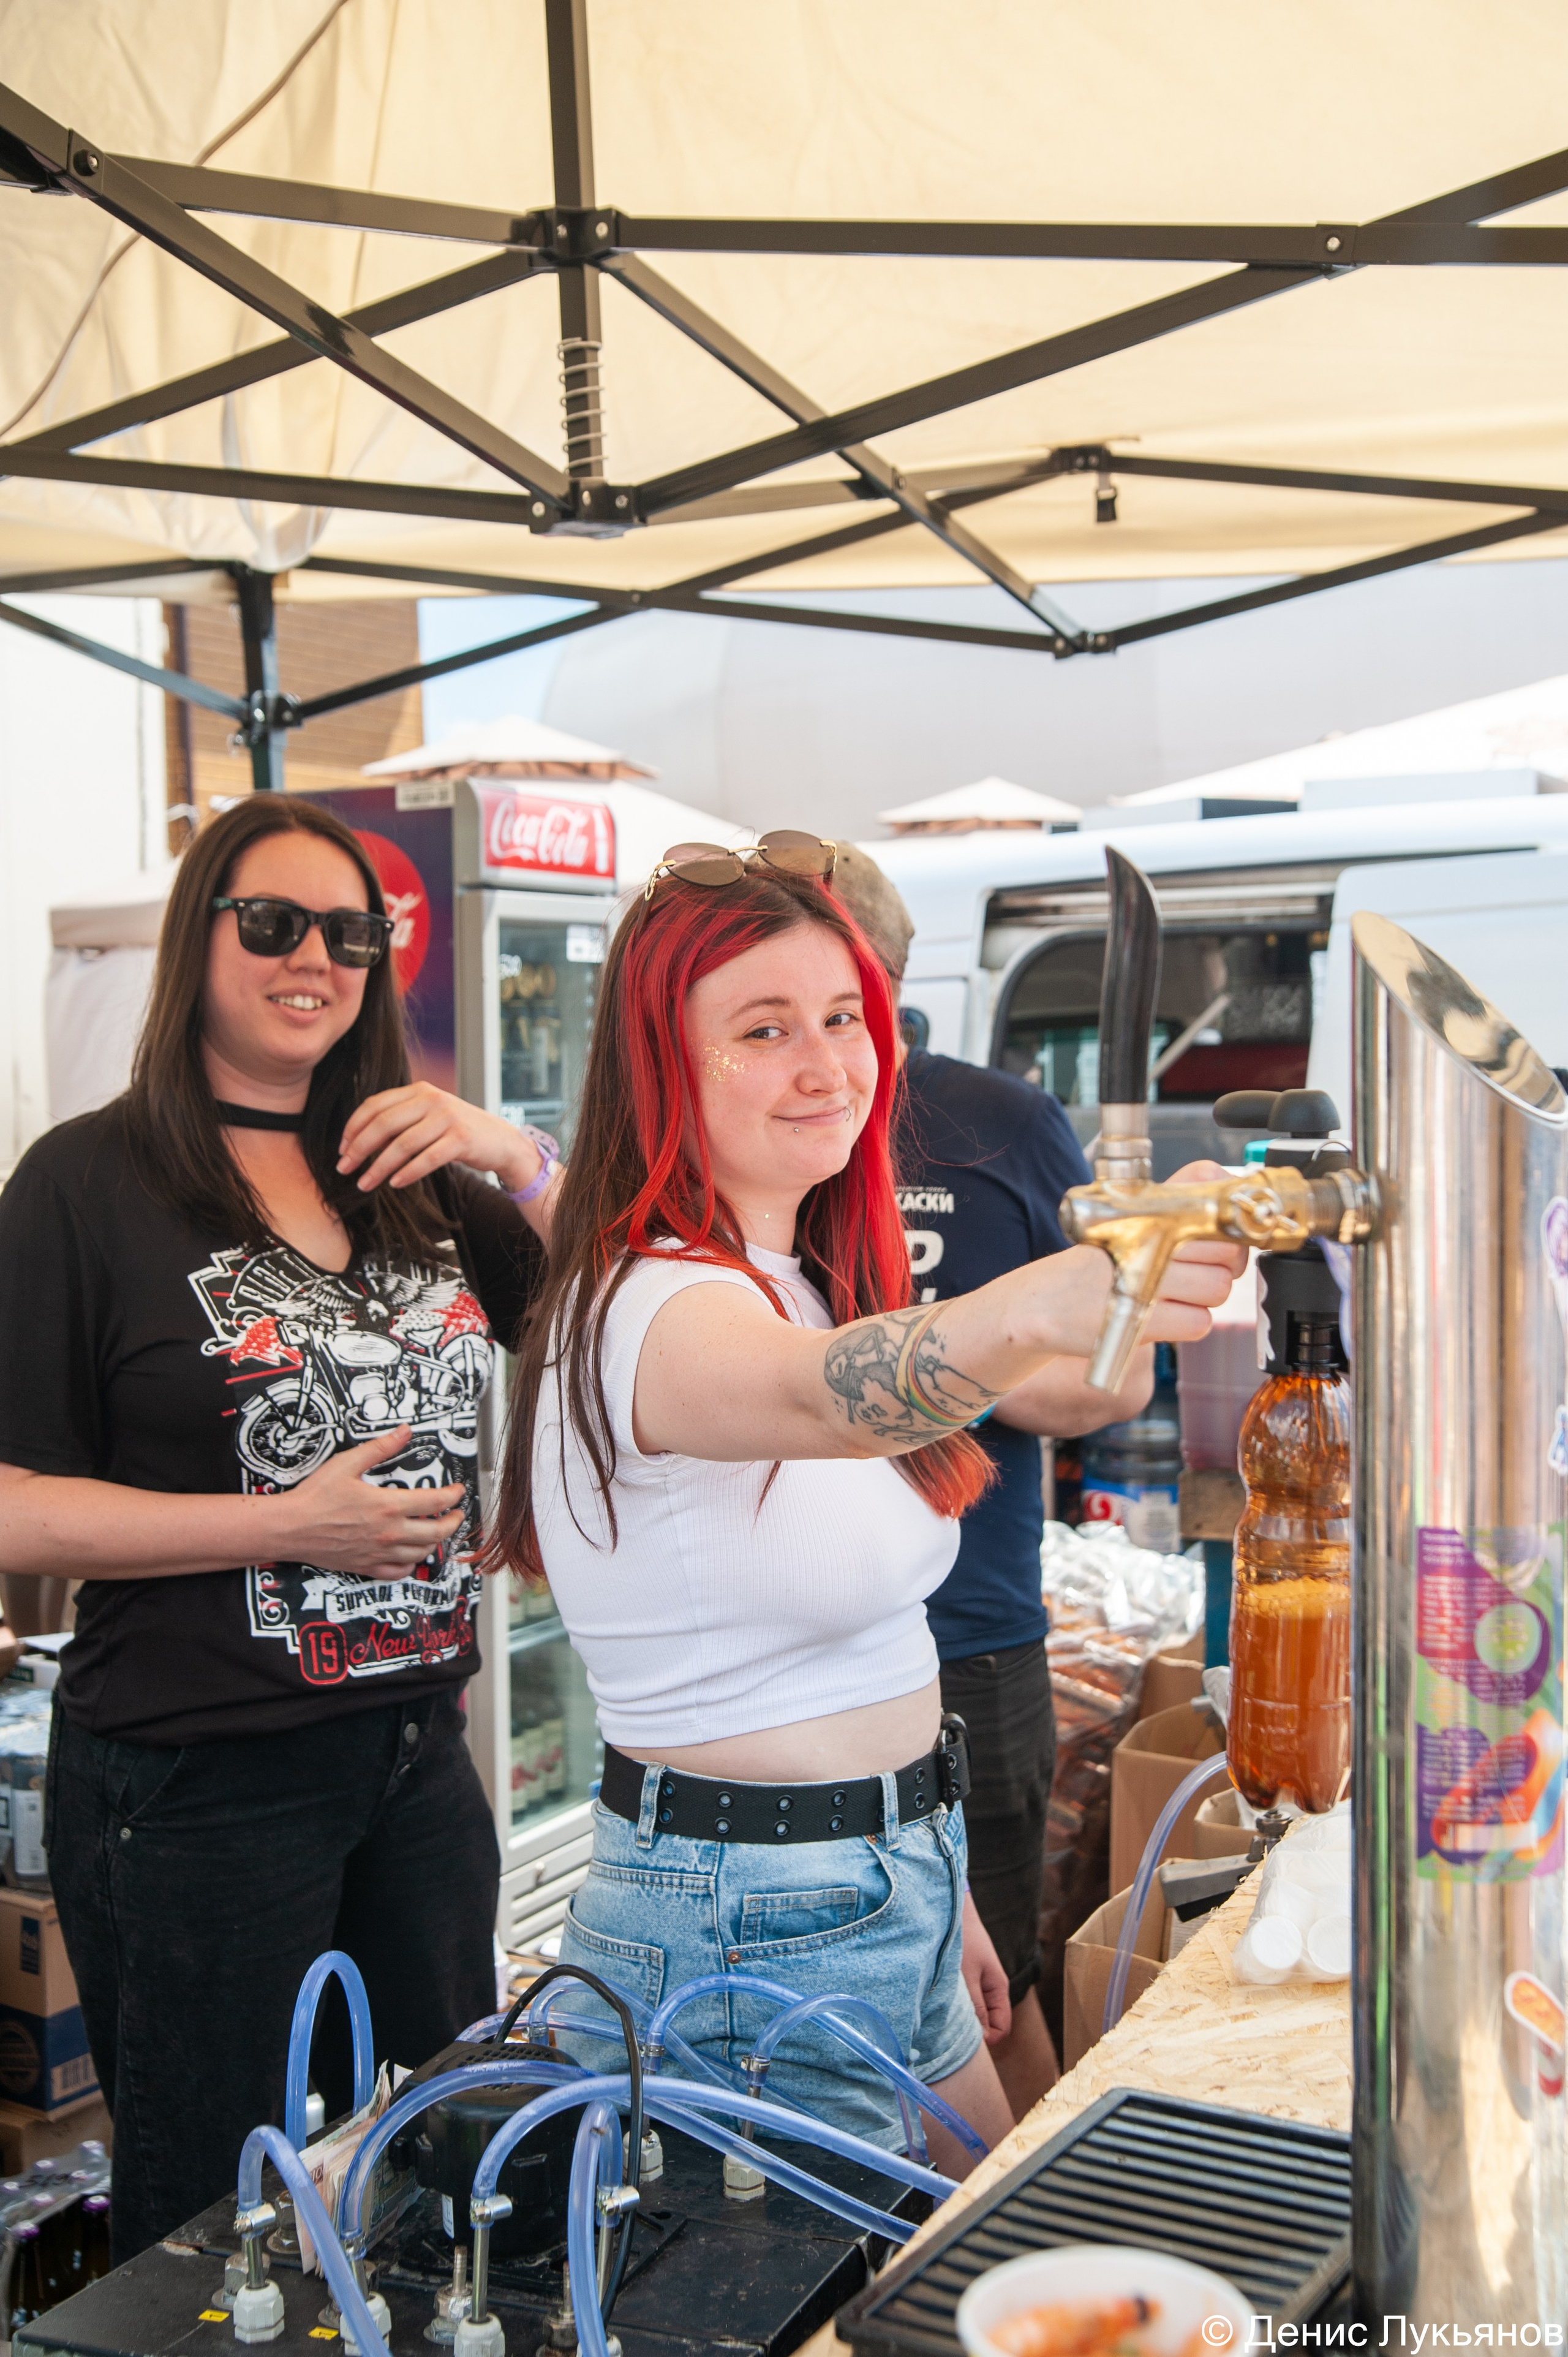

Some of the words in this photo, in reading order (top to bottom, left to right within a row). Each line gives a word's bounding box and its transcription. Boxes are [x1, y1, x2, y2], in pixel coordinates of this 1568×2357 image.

[491, 798, 589, 867] Coca-Cola
[308, 1632, 338, 1674] 19
[350, 1622, 417, 1665] New
